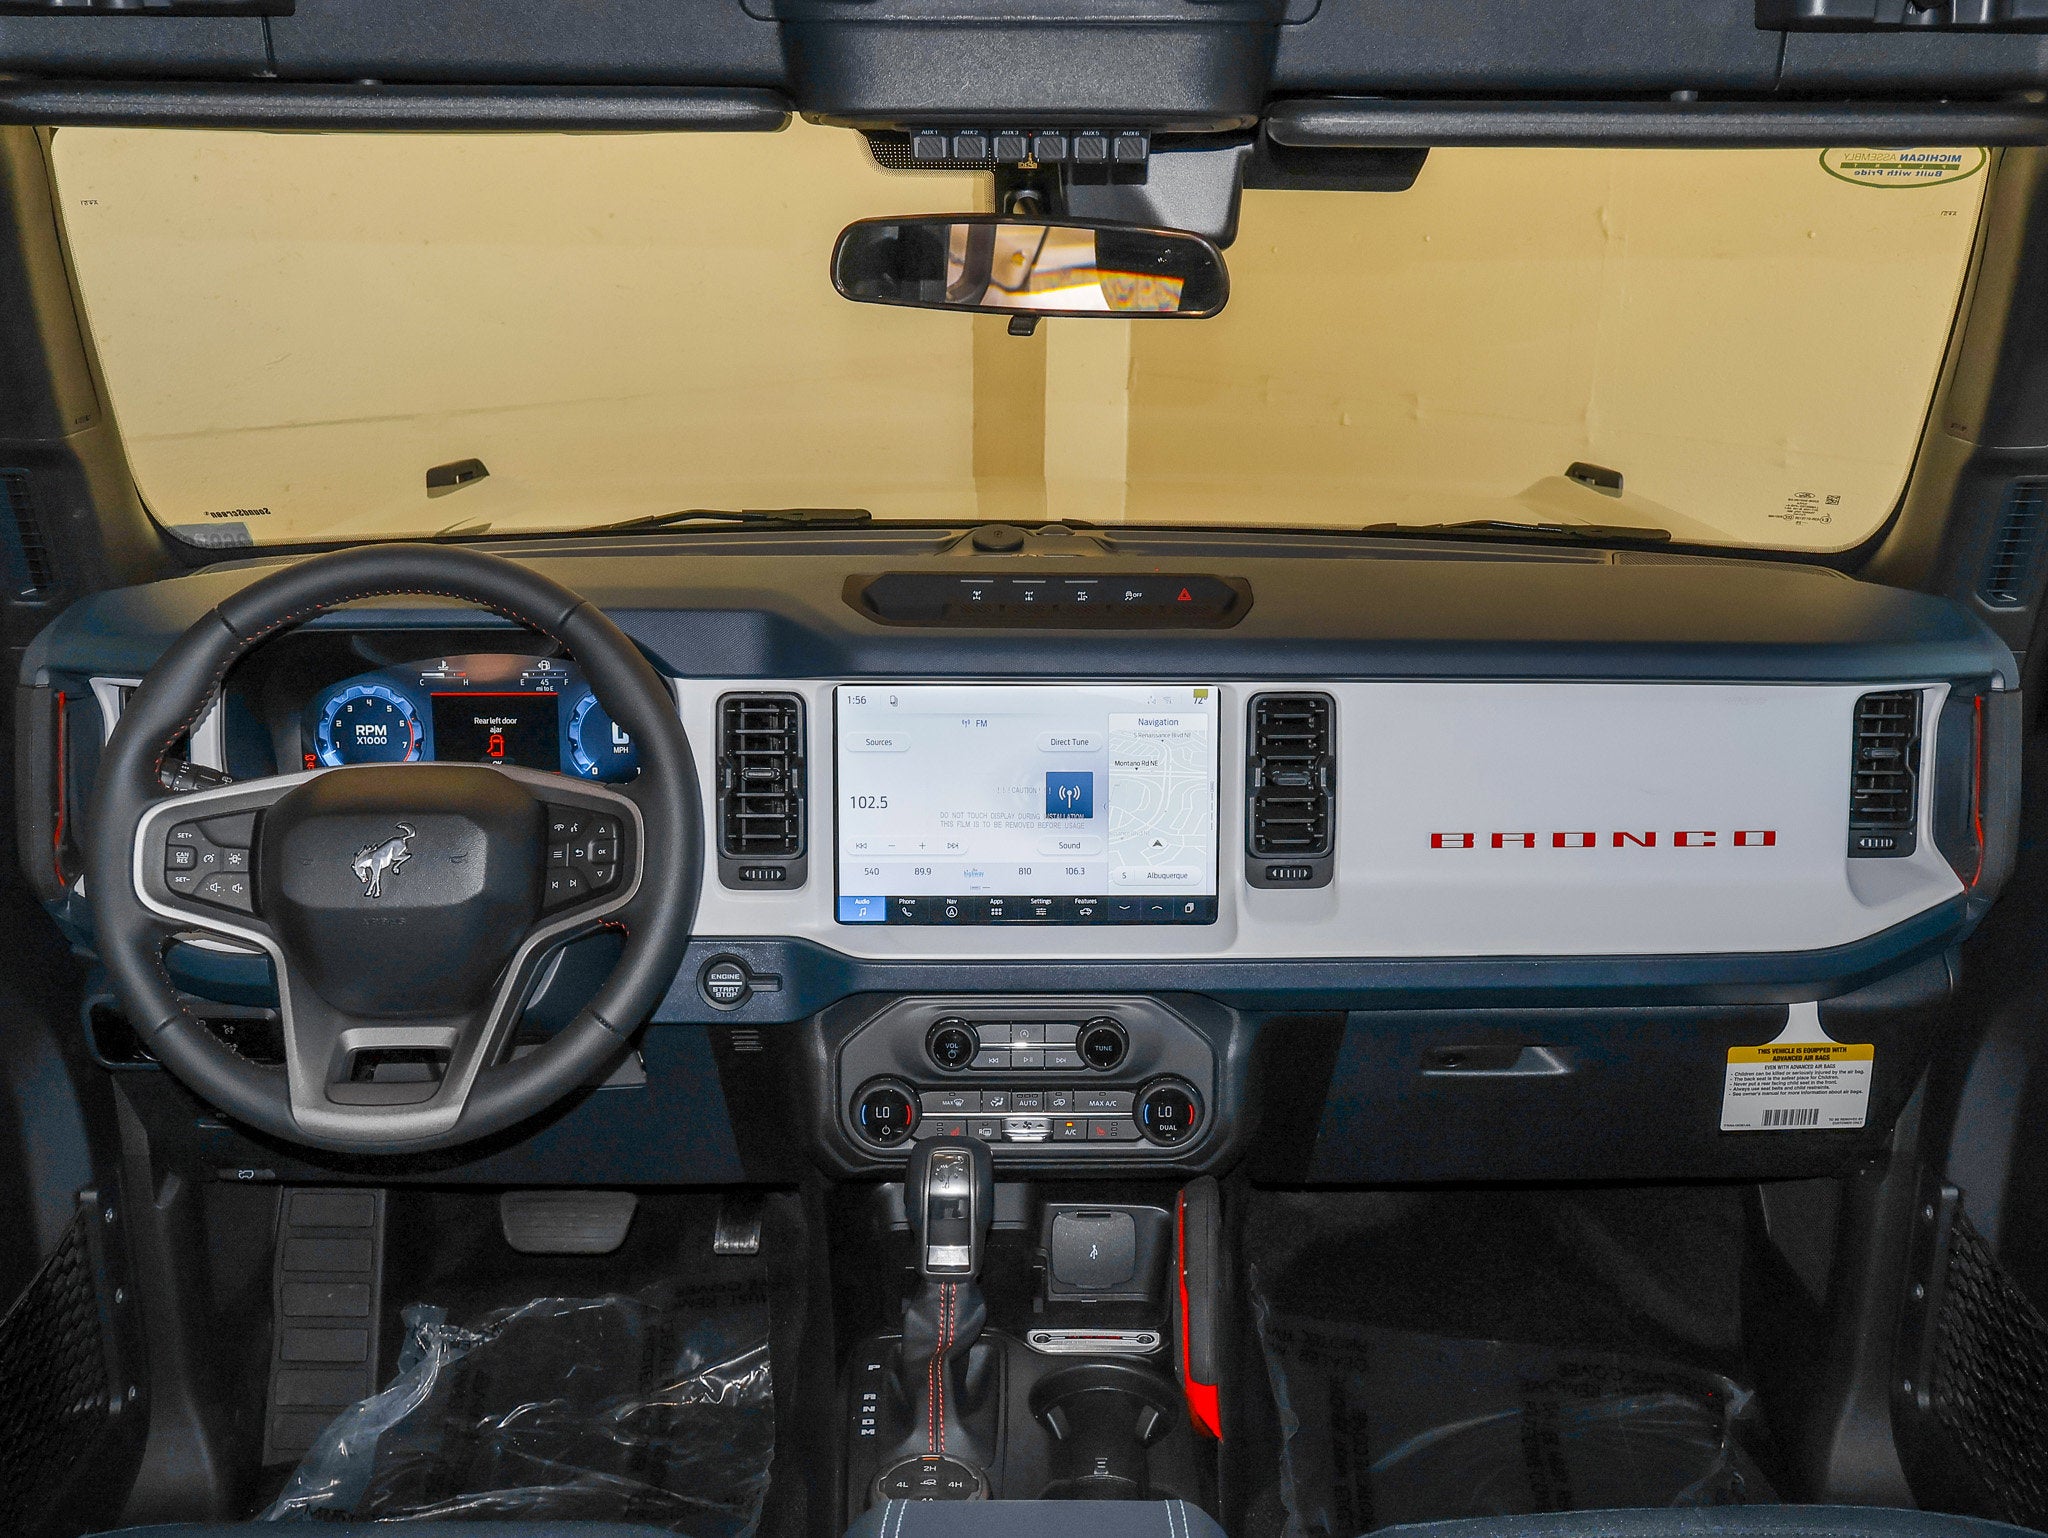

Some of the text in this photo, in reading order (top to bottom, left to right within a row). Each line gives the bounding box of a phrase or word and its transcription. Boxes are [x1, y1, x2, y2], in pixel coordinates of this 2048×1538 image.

[847, 695, 866, 704] 1:56
[976, 720, 988, 728] FM
[1138, 718, 1179, 728] Navigation
[355, 725, 387, 735] RPM
[490, 726, 502, 734] ajar
[356, 737, 387, 745] X1000
[865, 738, 892, 746] Sources
[1050, 738, 1089, 746] Direct Tune
[592, 767, 598, 775] 0
[850, 795, 888, 809] 102.5
[1430, 831, 1776, 848] BRONCO
[1065, 867, 1085, 875] 106.3
[1147, 872, 1188, 880] Albuquerque
[875, 1107, 890, 1118] LO
[1158, 1106, 1172, 1118] LO
